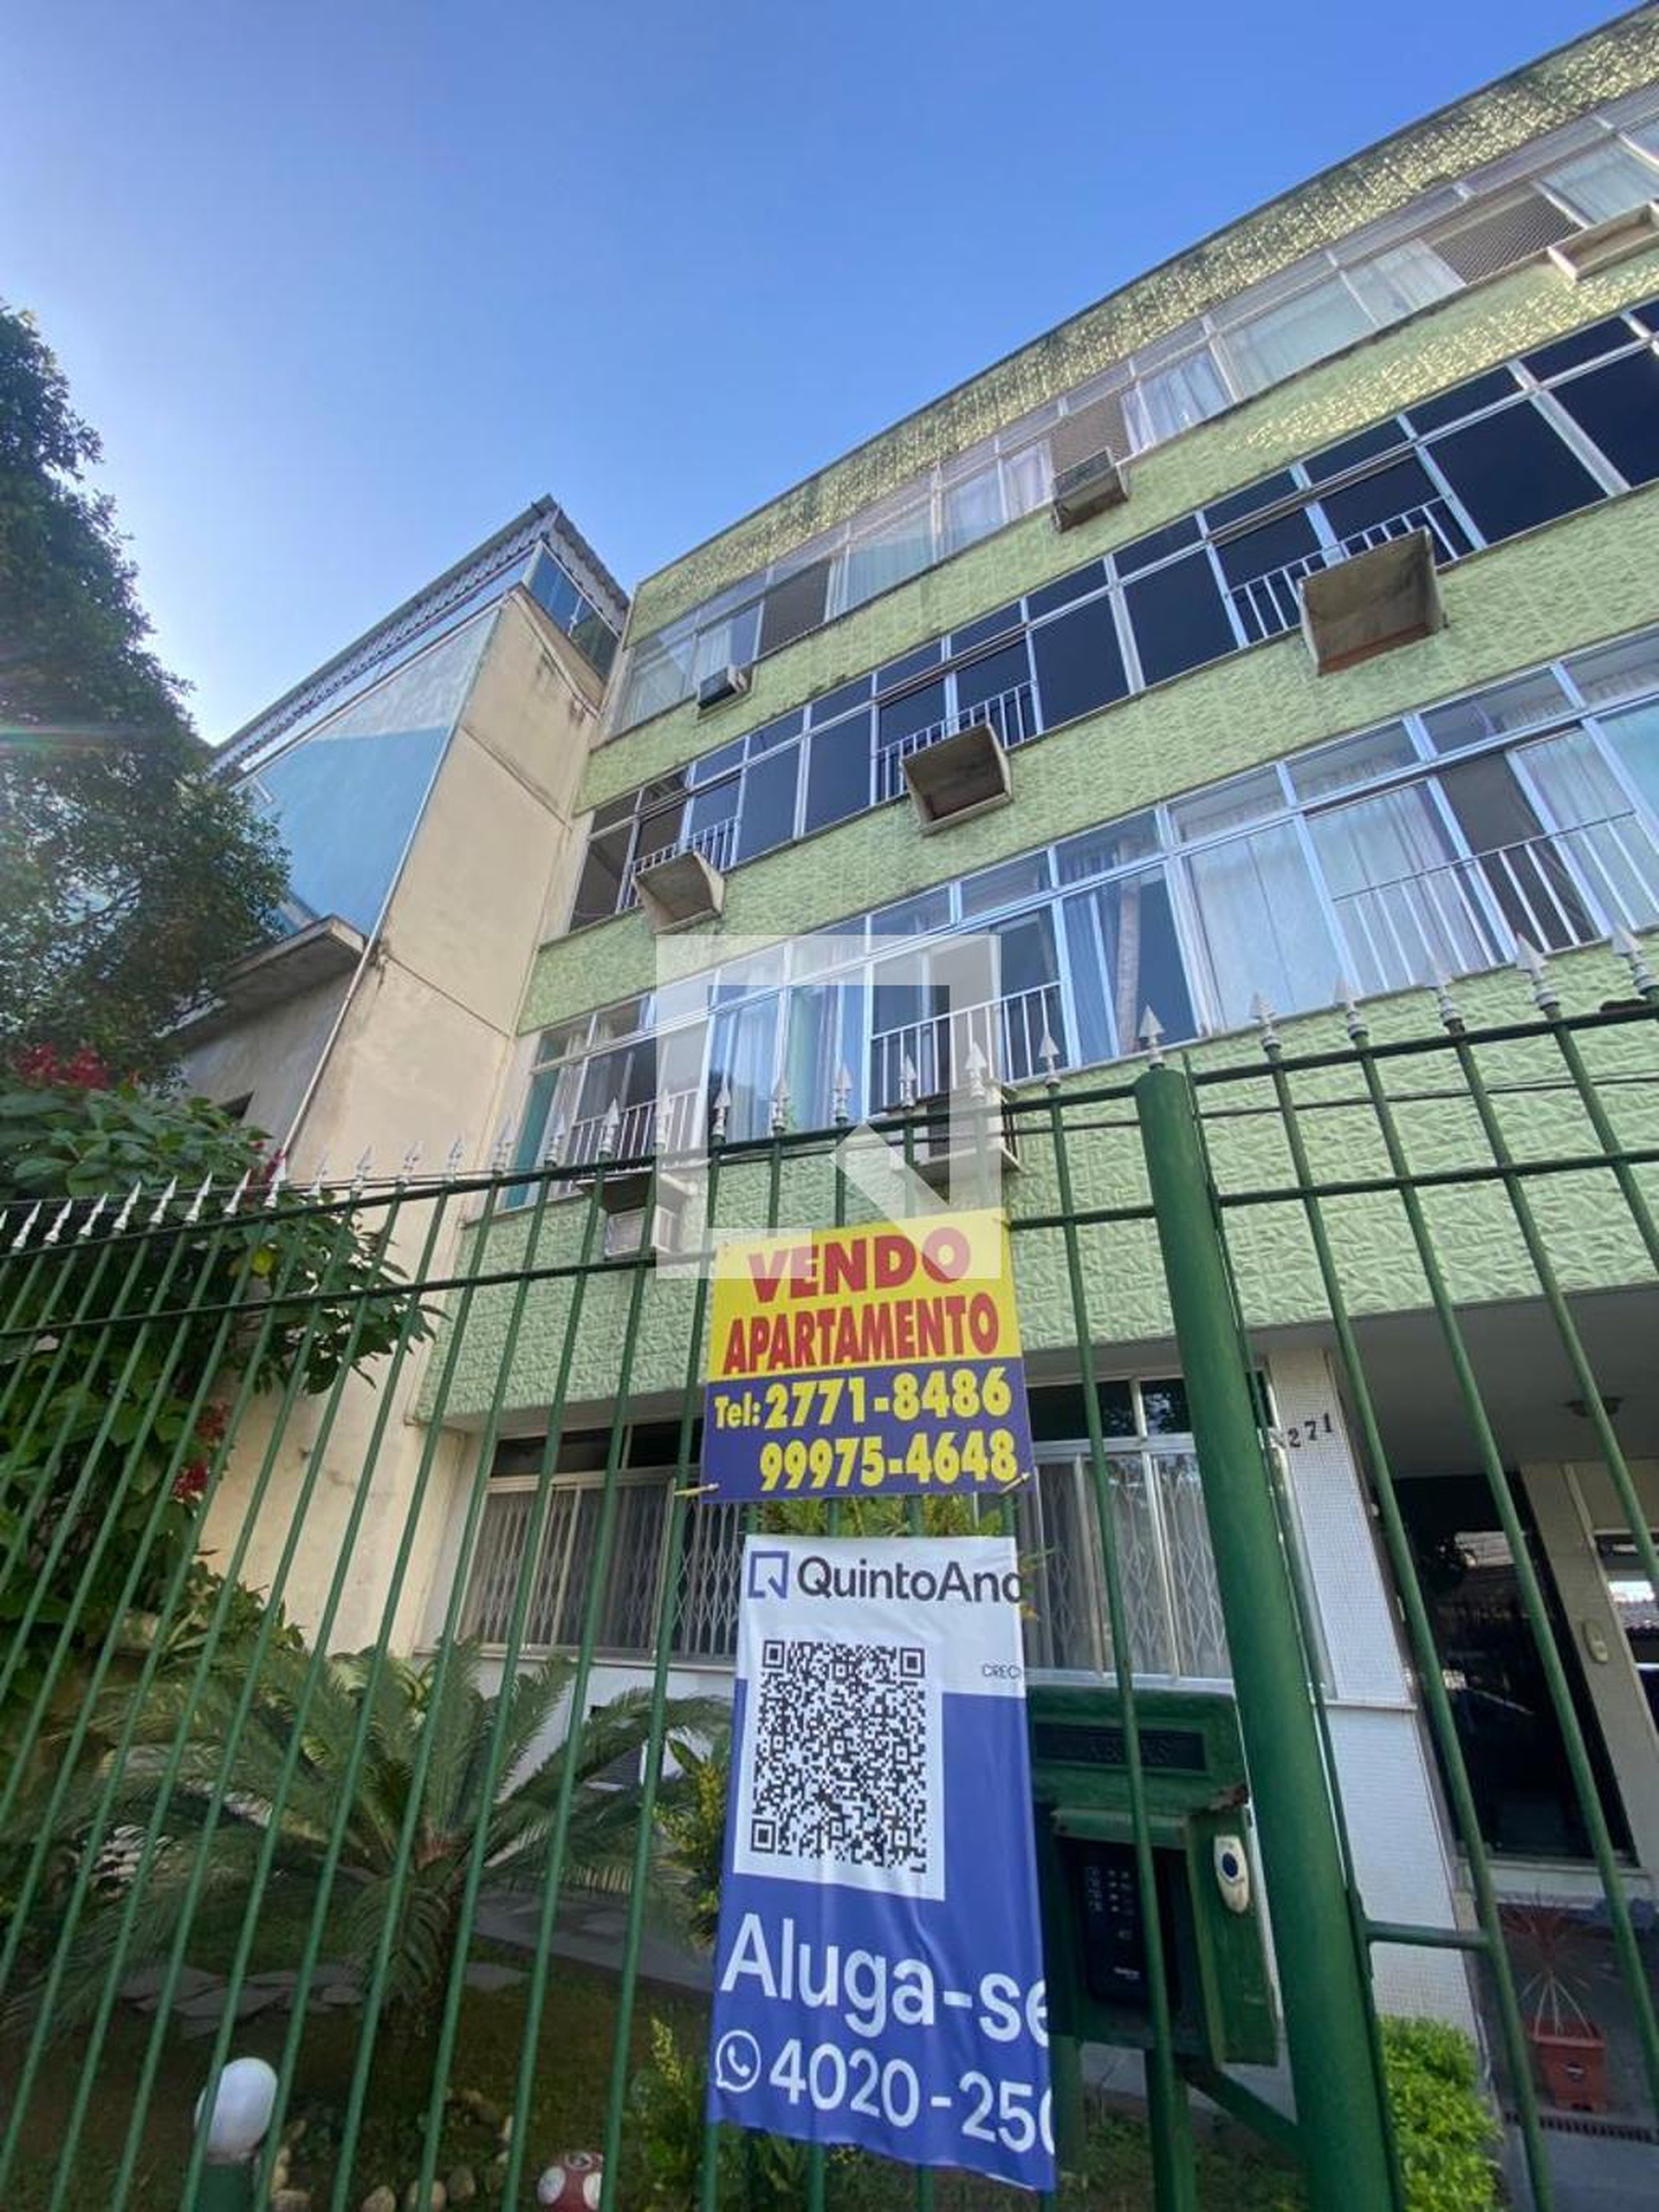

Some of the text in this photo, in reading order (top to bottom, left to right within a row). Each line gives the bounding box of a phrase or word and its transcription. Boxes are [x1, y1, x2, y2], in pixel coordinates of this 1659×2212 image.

[748, 1226, 971, 1303] VENDO
[723, 1291, 999, 1375] APARTAMENTO
[714, 1367, 1012, 1430] Tel: 2771-8486
[759, 1429, 1018, 1492] 99975-4648
[1288, 1413, 1333, 1448] 271
